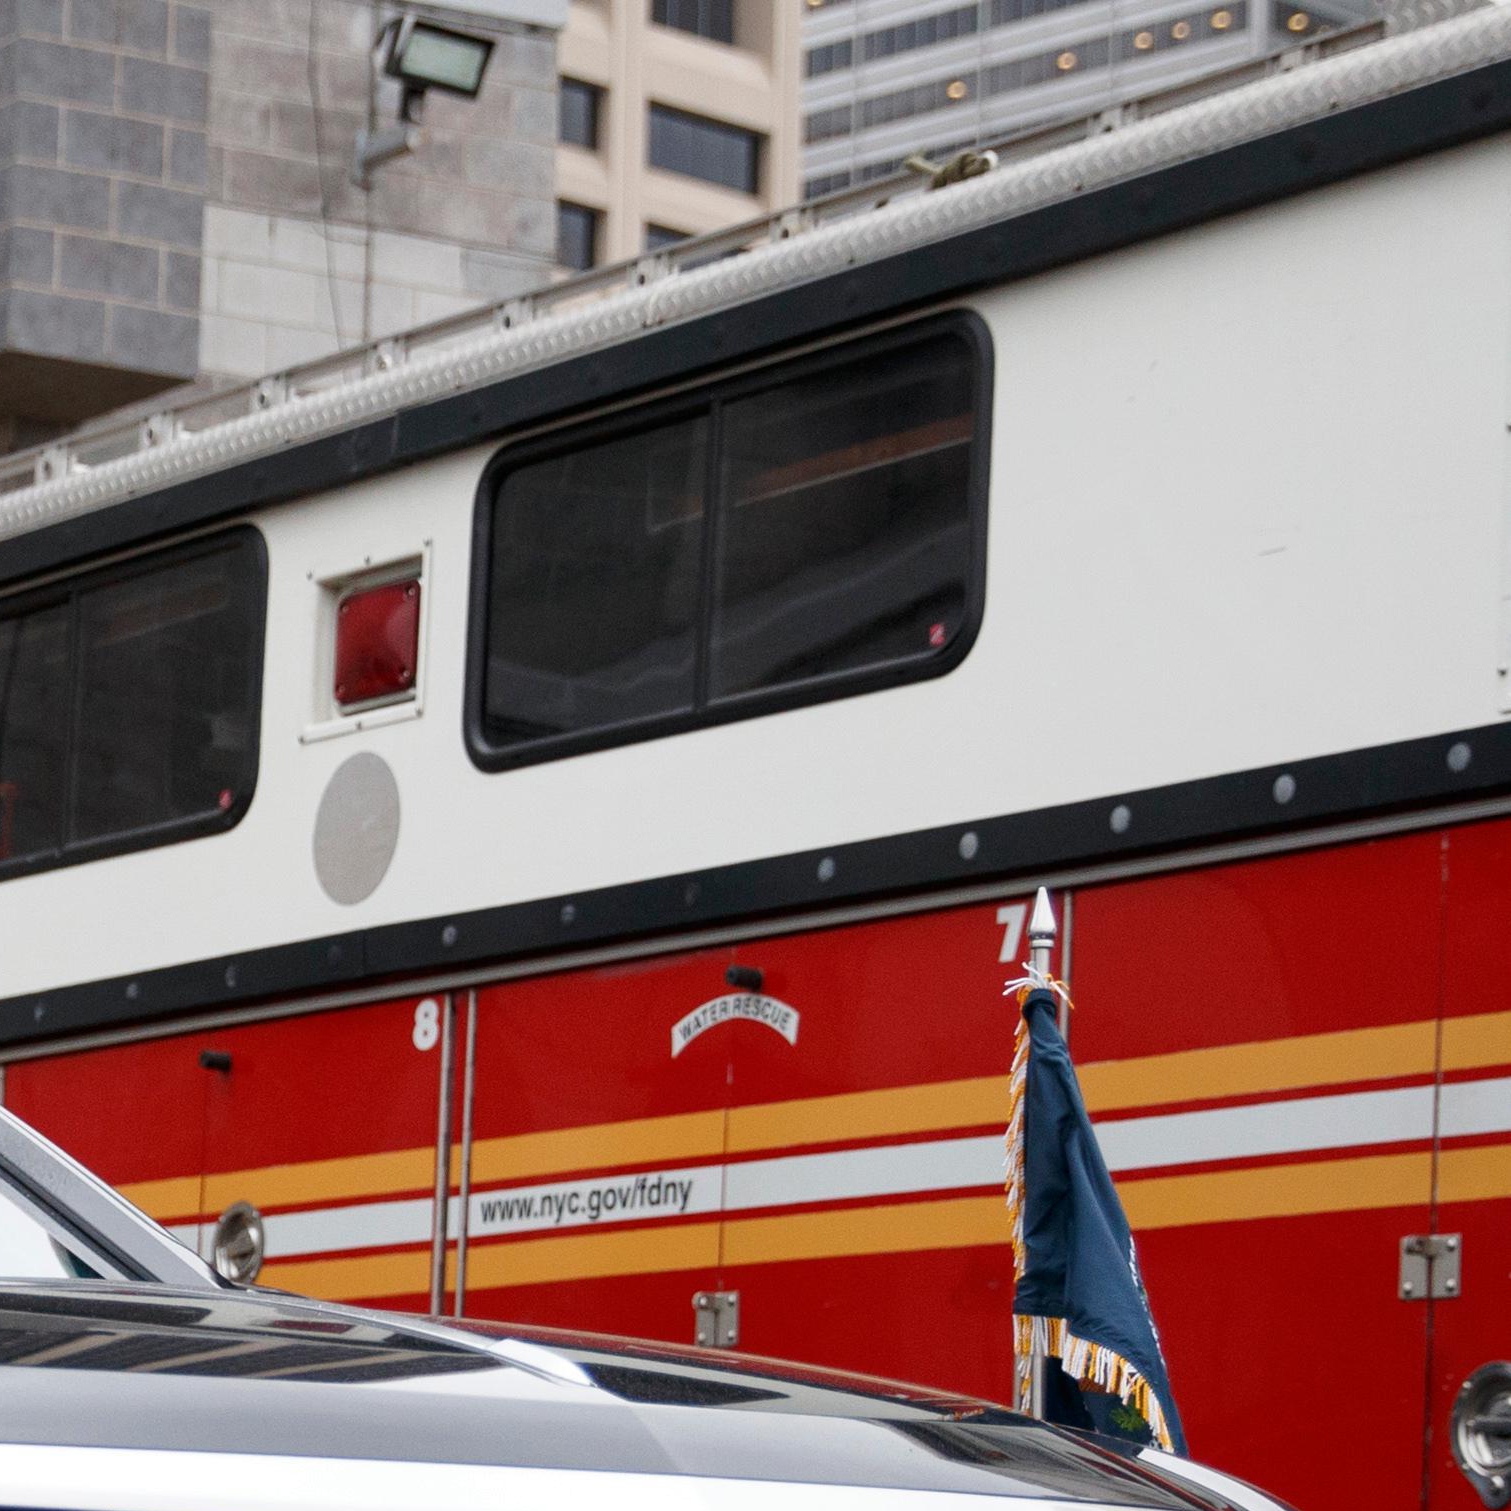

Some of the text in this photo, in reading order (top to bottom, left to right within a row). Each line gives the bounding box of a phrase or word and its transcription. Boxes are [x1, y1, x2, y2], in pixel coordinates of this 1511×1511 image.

[997, 905, 1025, 964] 7
[412, 999, 439, 1052] 8
[680, 996, 792, 1041] WATER RESCUE
[480, 1174, 694, 1224] www.nyc.gov/fdny
